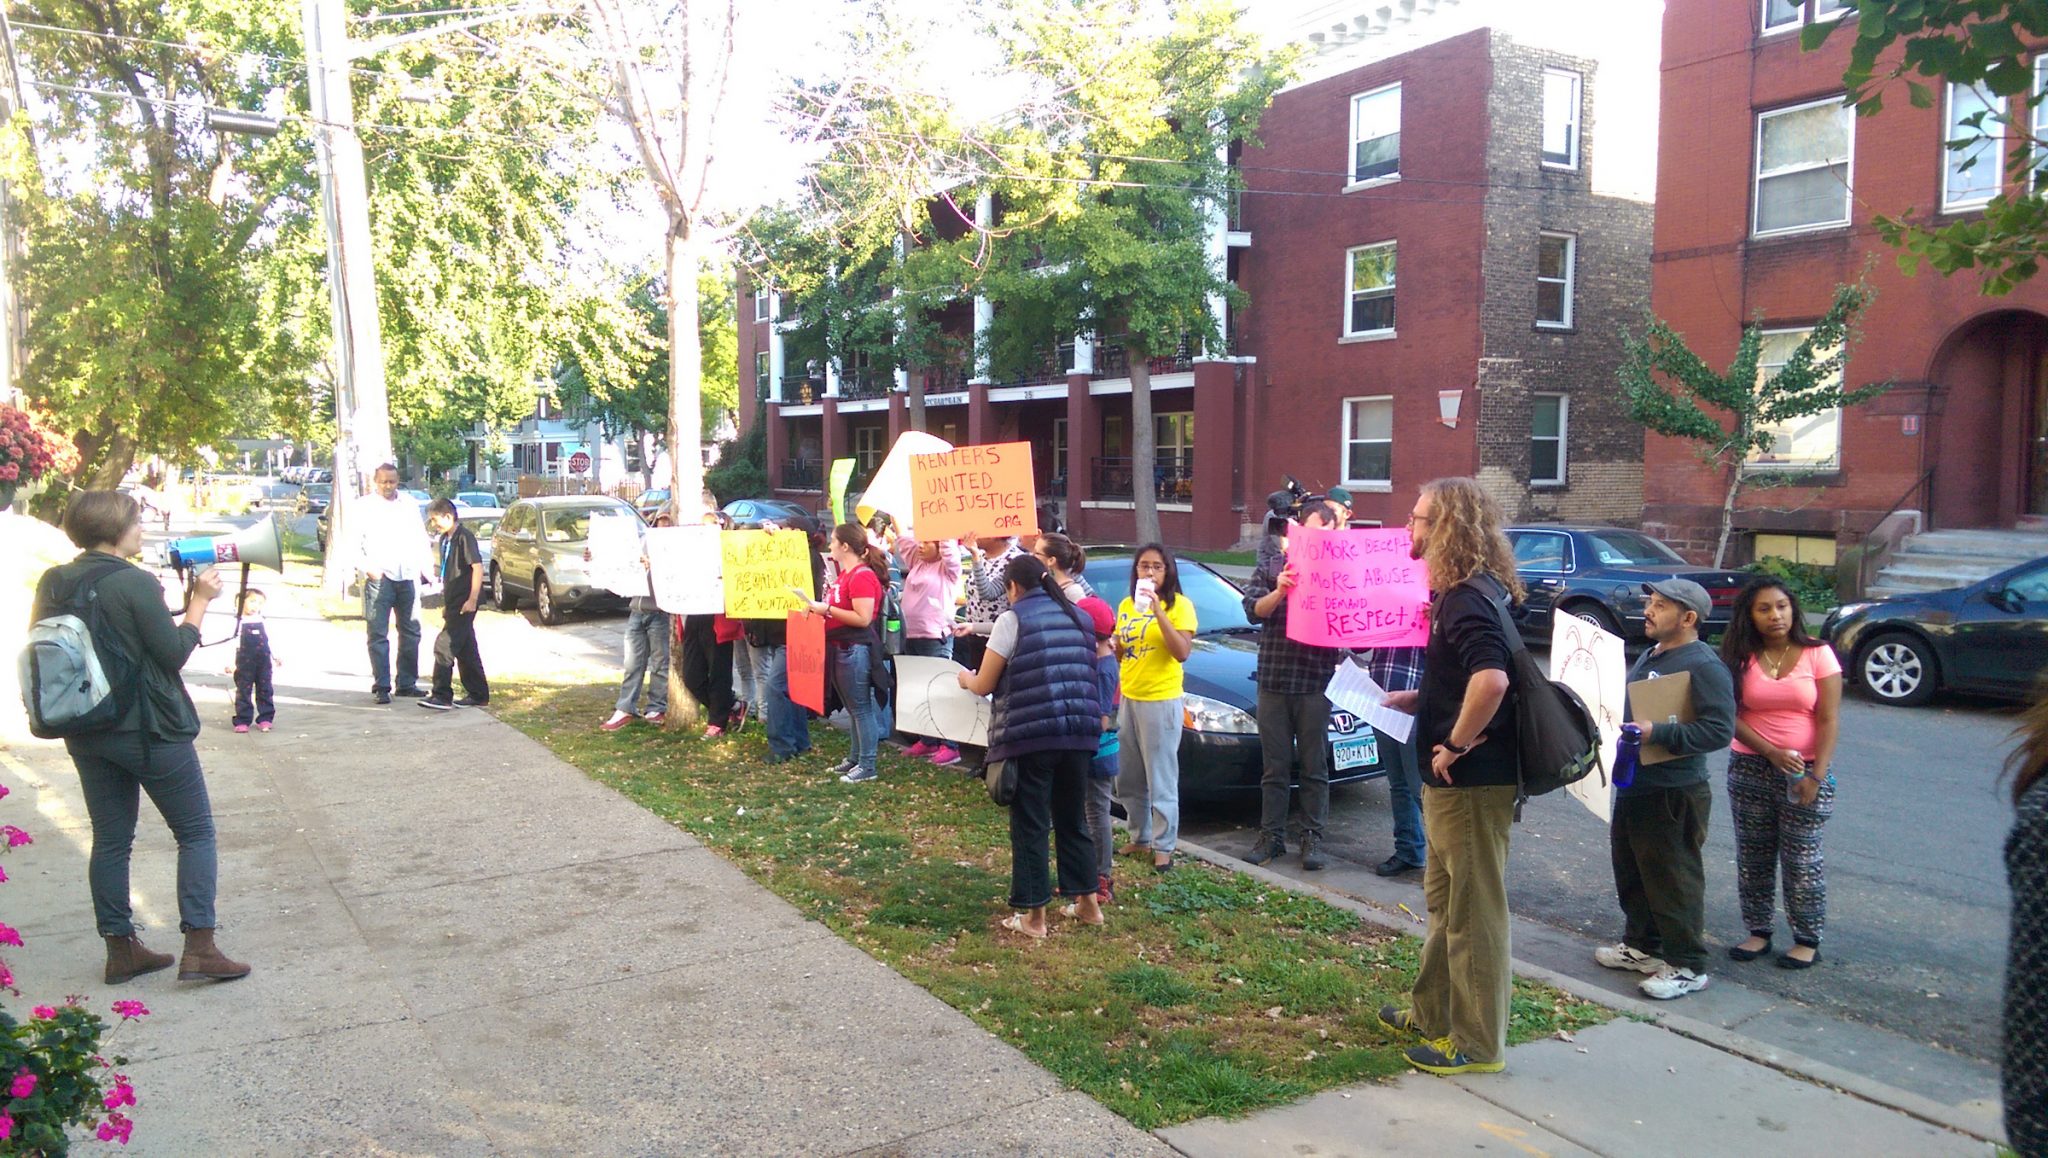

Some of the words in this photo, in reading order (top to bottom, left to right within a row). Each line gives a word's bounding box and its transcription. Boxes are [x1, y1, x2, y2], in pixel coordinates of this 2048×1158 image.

[571, 458, 590, 467] STOP
[916, 447, 1001, 471] RENTERS
[927, 472, 993, 494] UNITED
[921, 498, 949, 518] FOR
[956, 492, 1026, 512] JUSTICE
[994, 515, 1022, 528] ORG
[1362, 567, 1415, 588] ABUSE
[1325, 597, 1368, 610] DEMAND
